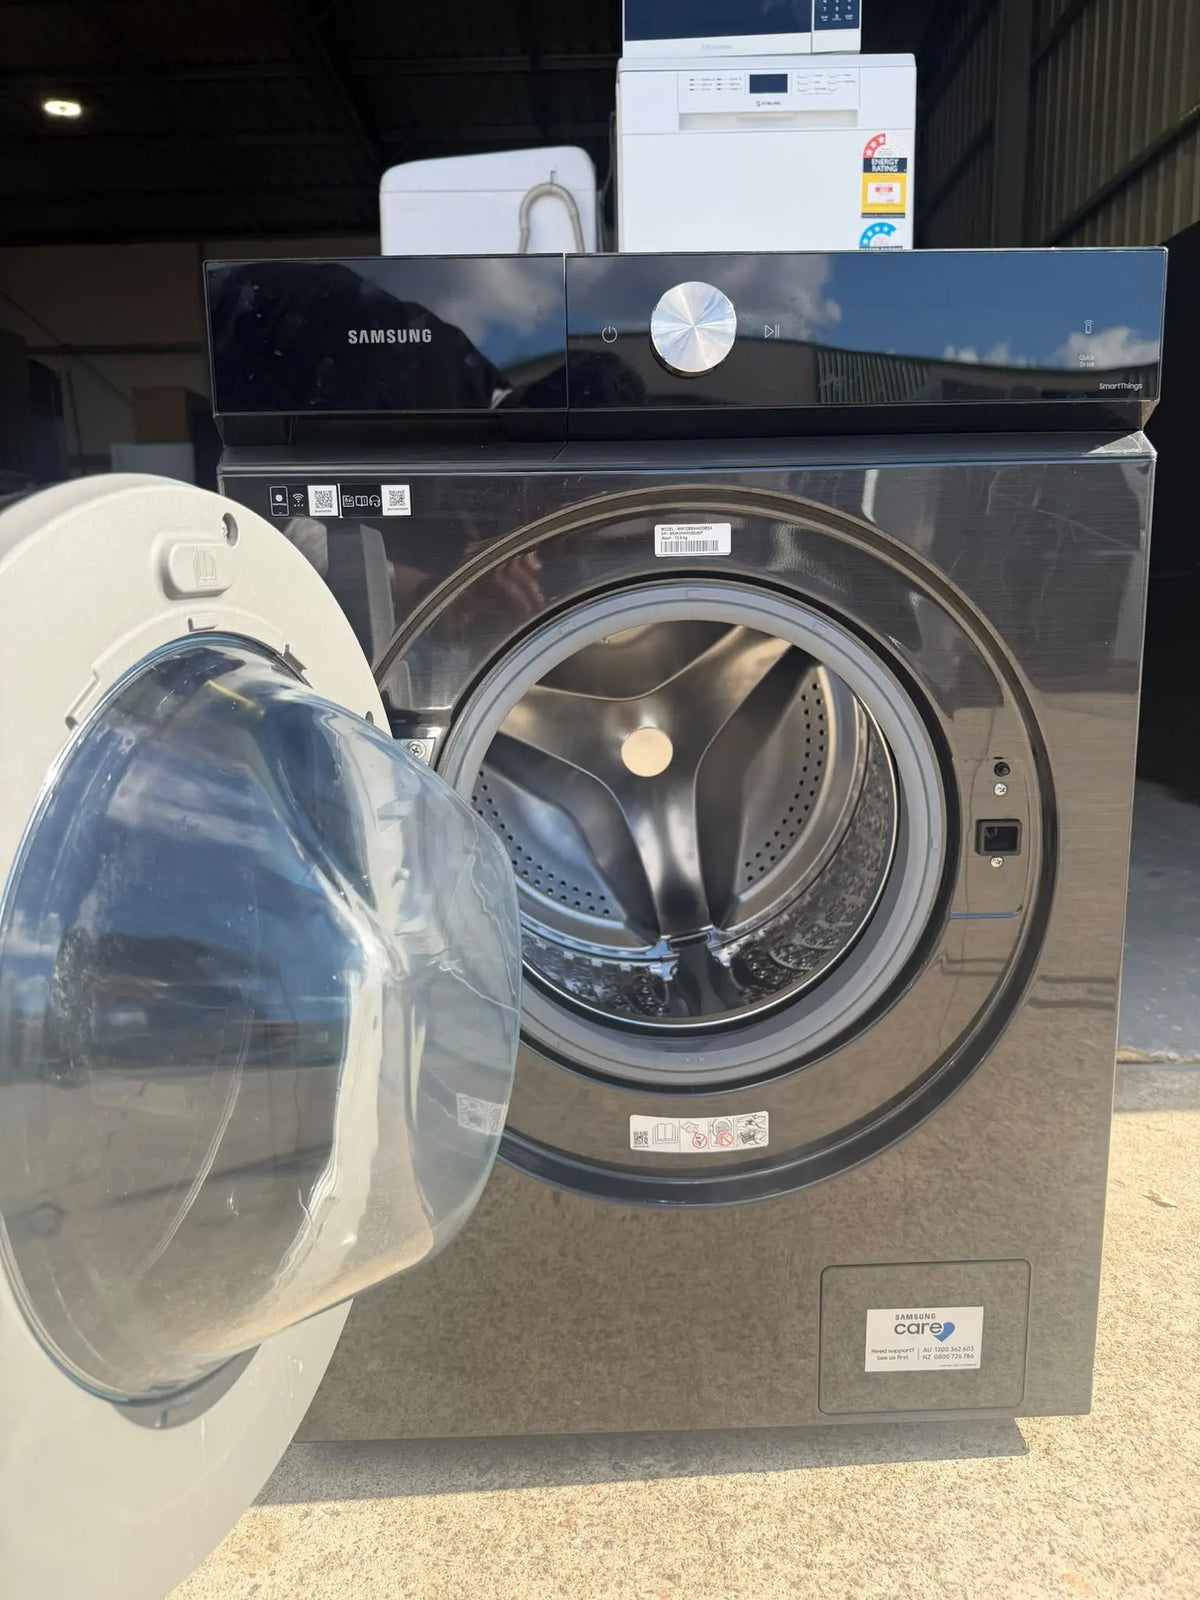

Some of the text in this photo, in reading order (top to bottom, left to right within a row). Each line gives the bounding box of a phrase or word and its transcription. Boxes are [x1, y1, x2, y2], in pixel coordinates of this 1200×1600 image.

[871, 158, 900, 166] ENERGY
[871, 165, 898, 173] RATING
[347, 328, 432, 345] SAMSUNG
[1098, 382, 1143, 391] SmartThings
[895, 1313, 936, 1321] SAMSUNG
[894, 1322, 943, 1335] care
[888, 1347, 915, 1355] support?
